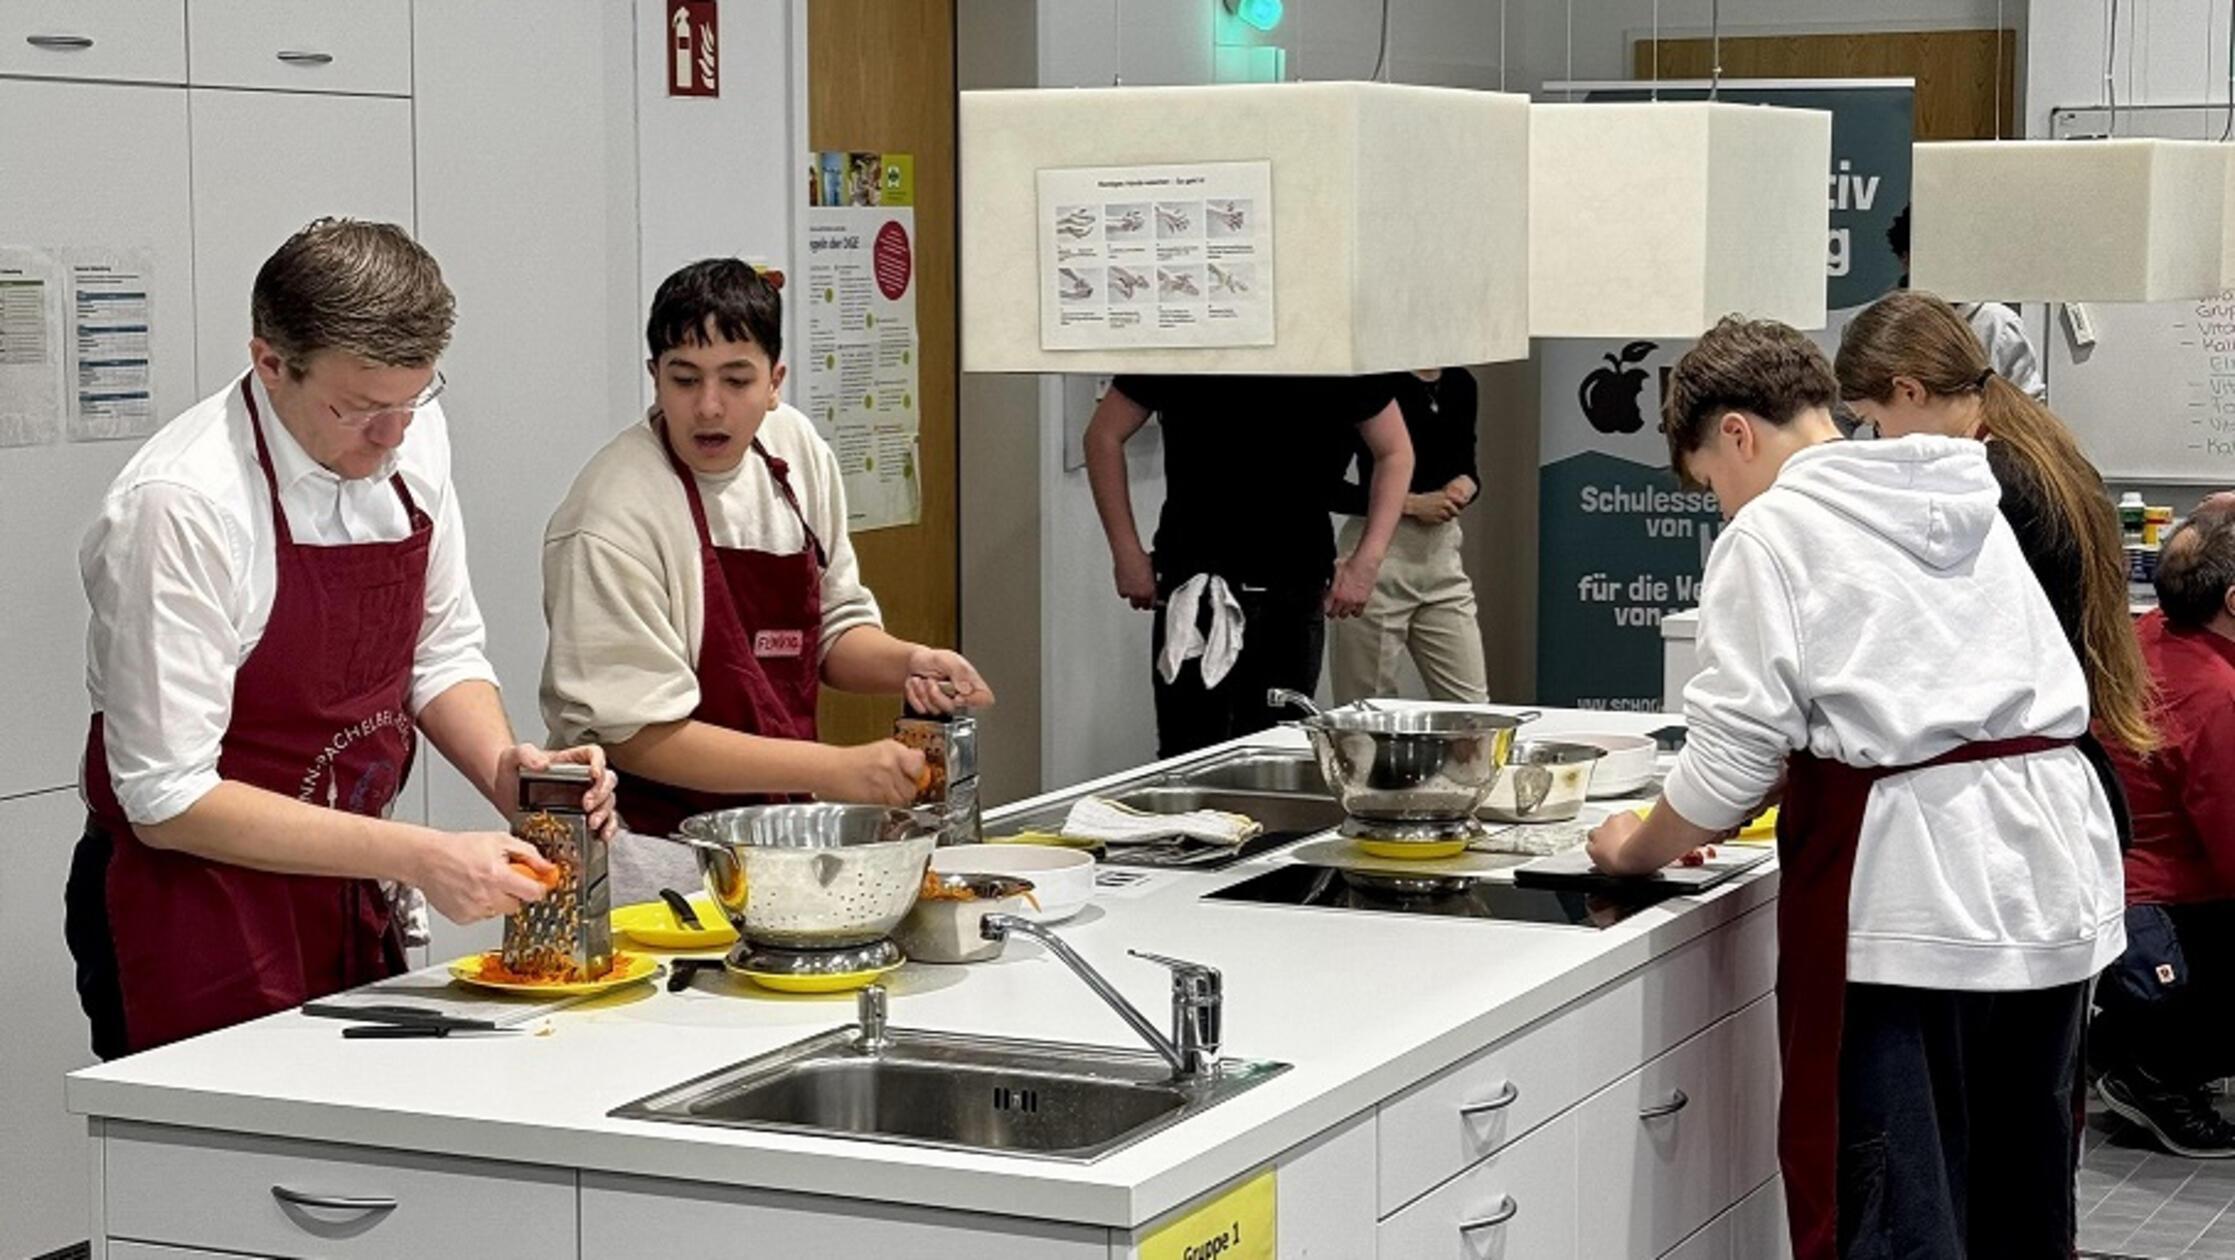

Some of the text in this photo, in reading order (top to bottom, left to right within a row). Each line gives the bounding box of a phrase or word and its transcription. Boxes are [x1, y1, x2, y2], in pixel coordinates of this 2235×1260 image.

[1579, 484, 1722, 513] Schulesse
[1645, 517, 1692, 538] von
[1577, 573, 1622, 601] für
[1628, 574, 1668, 601] die
[1614, 607, 1662, 627] von
[1232, 1220, 1240, 1245] 1
